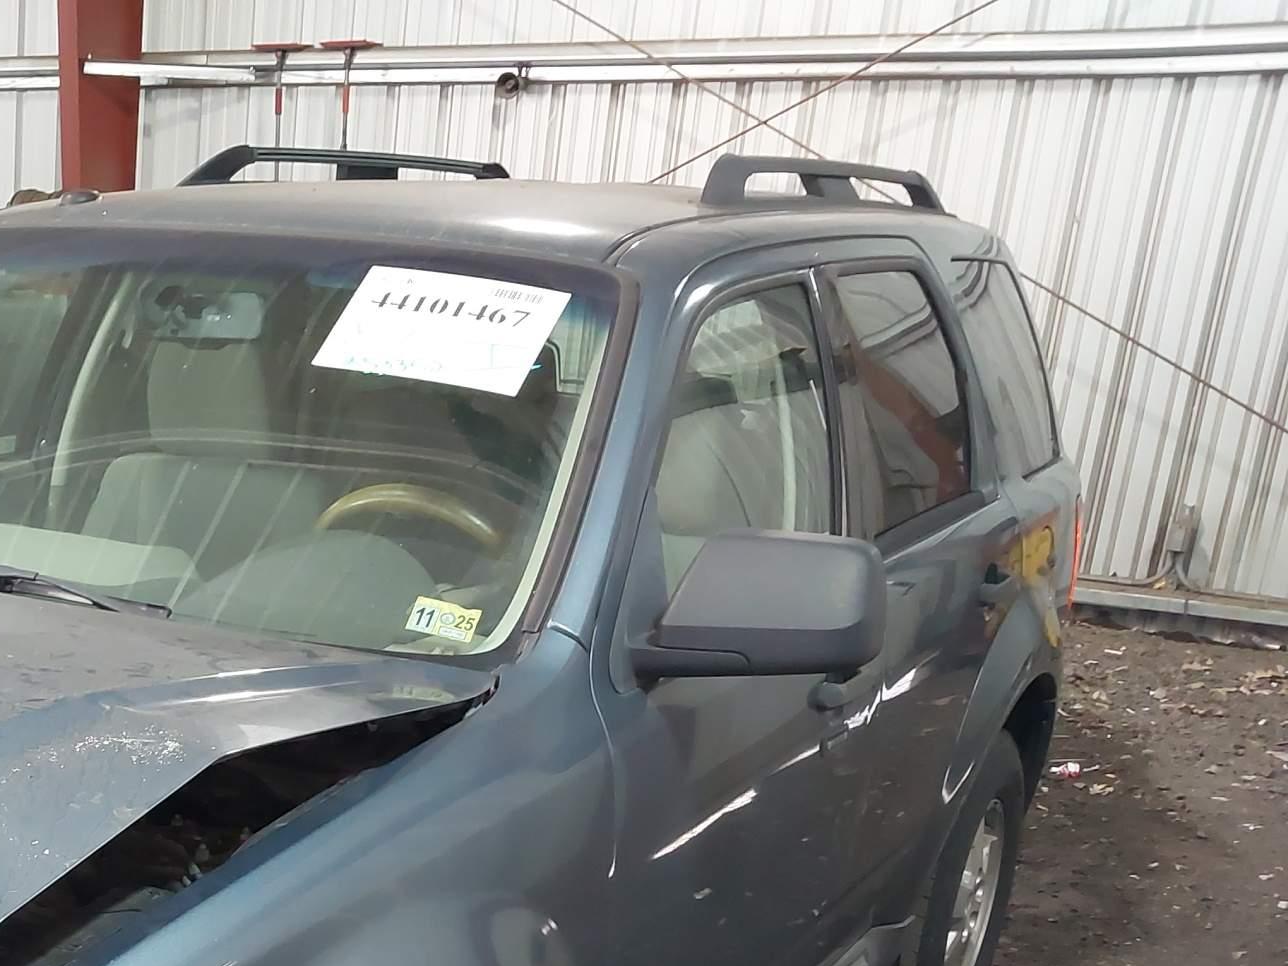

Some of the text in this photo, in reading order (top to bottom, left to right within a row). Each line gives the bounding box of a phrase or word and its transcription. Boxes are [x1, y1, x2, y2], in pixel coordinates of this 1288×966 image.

[371, 291, 531, 327] 44101467
[415, 607, 475, 631] 11 25
